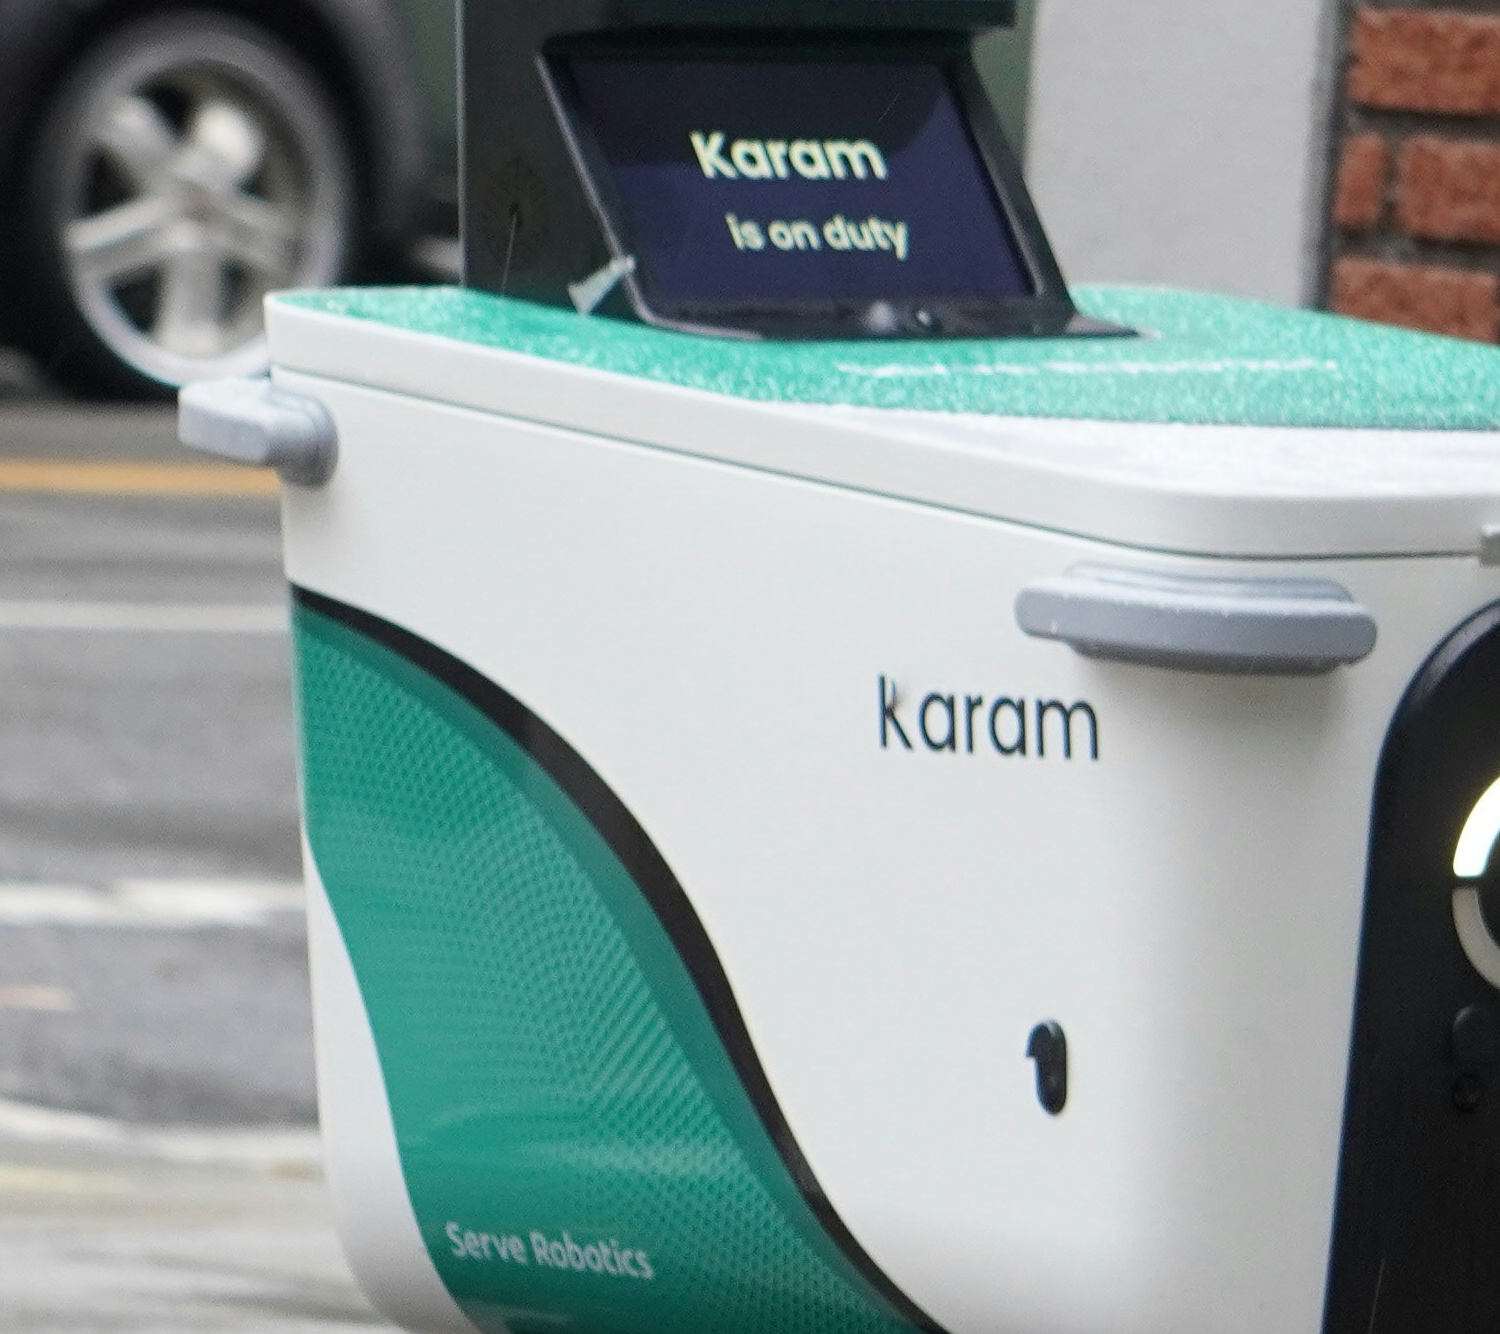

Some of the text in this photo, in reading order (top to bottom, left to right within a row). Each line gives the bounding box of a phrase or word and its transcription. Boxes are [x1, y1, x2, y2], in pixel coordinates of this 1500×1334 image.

[689, 130, 888, 180] Karam
[767, 220, 822, 251] on
[822, 214, 909, 261] duty
[445, 1221, 654, 1280] Serve Robotics
